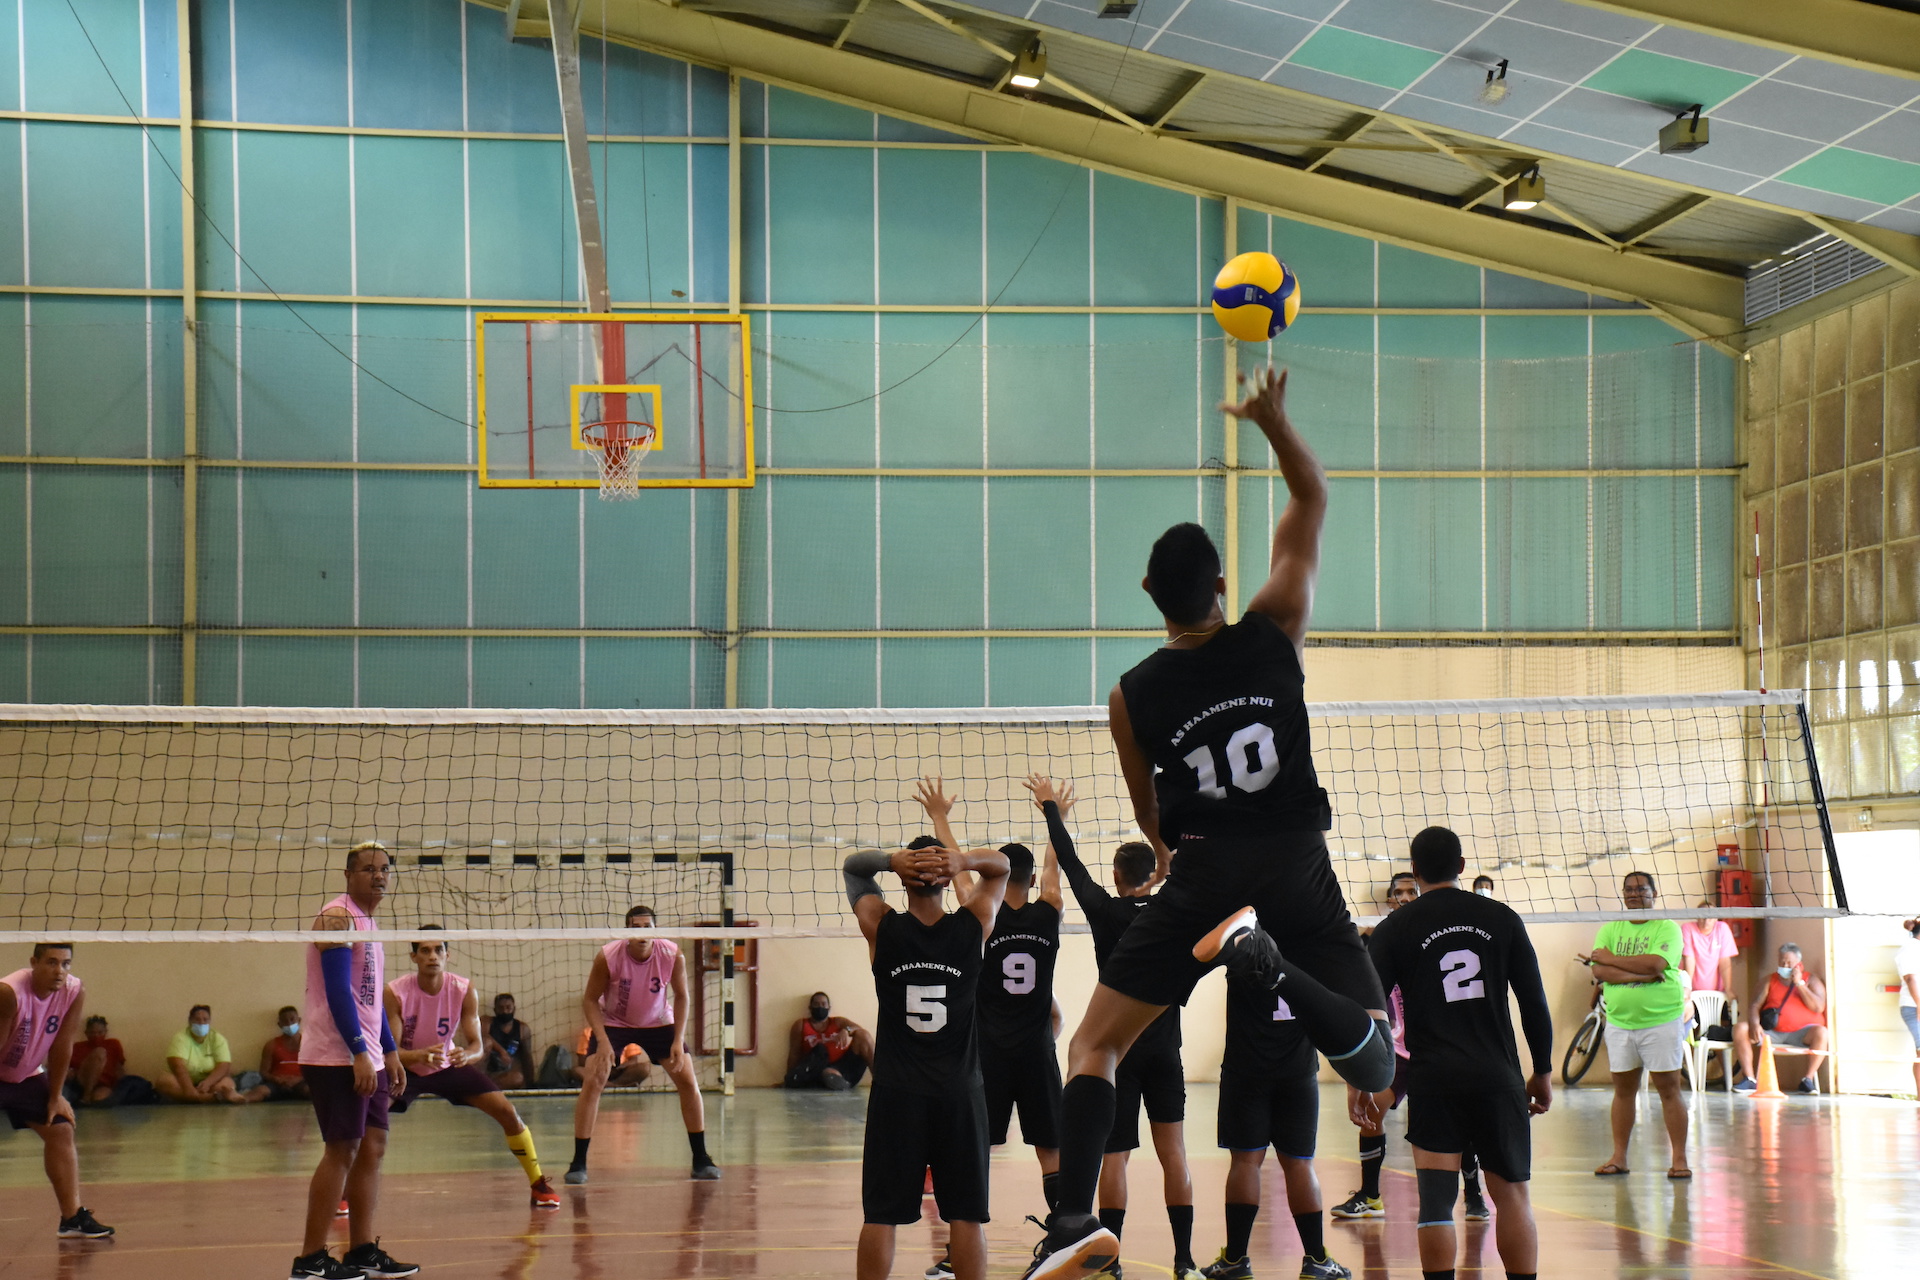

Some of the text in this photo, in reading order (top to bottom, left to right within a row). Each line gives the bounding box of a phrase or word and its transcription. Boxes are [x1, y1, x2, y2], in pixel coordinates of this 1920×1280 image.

[1170, 696, 1274, 747] AS HAAMENE NUI
[1183, 722, 1280, 799] 10
[990, 939, 999, 948] AS
[999, 934, 1037, 942] HAAMENE
[1421, 925, 1492, 950] AS HAAMENE NUI
[890, 962, 962, 977] AS HAAMENE NUI
[1002, 953, 1036, 994] 9
[1439, 949, 1485, 1003] 2
[649, 977, 661, 993] 3
[906, 984, 947, 1032] 5
[45, 1015, 59, 1034] 8
[437, 1018, 450, 1036] 5
